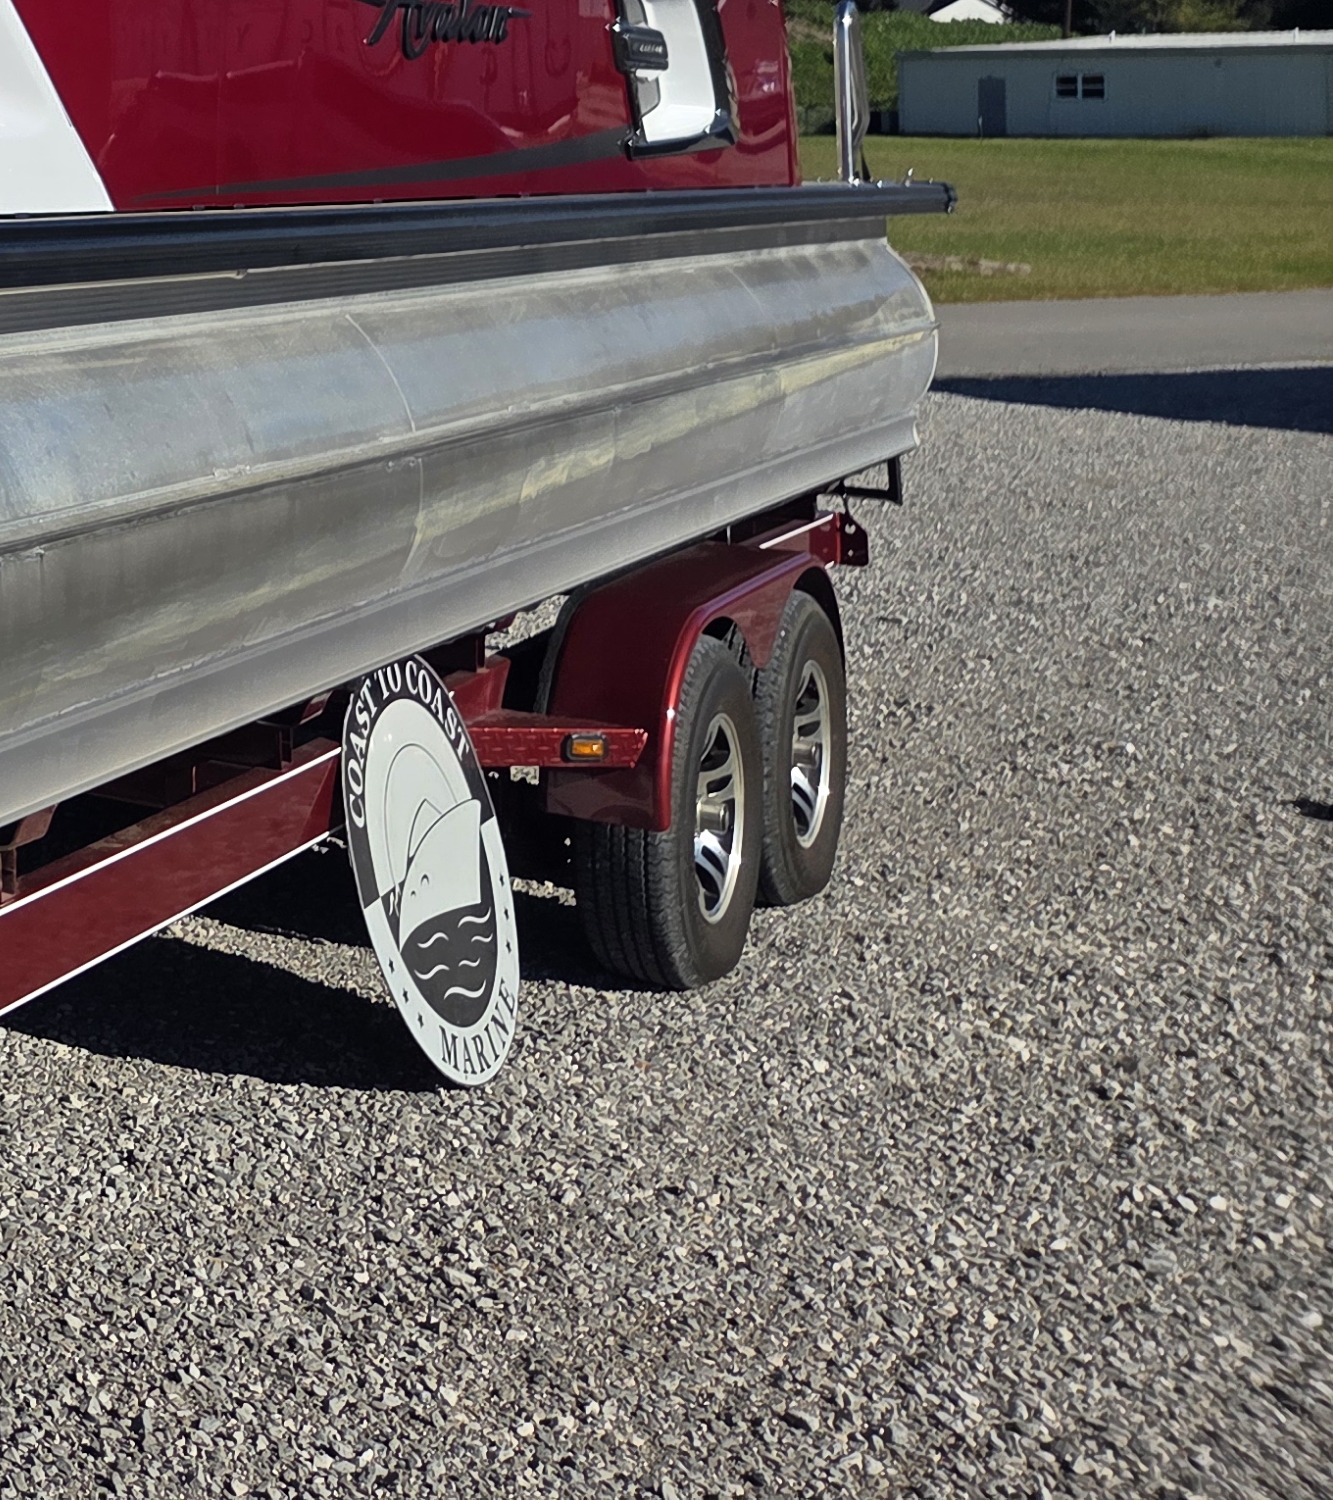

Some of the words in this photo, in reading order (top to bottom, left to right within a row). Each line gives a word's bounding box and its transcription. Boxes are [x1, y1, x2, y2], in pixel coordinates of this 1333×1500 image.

[347, 678, 378, 829] COAST
[374, 663, 402, 700] TO
[405, 660, 470, 761] COAST
[439, 976, 516, 1075] MARINE
